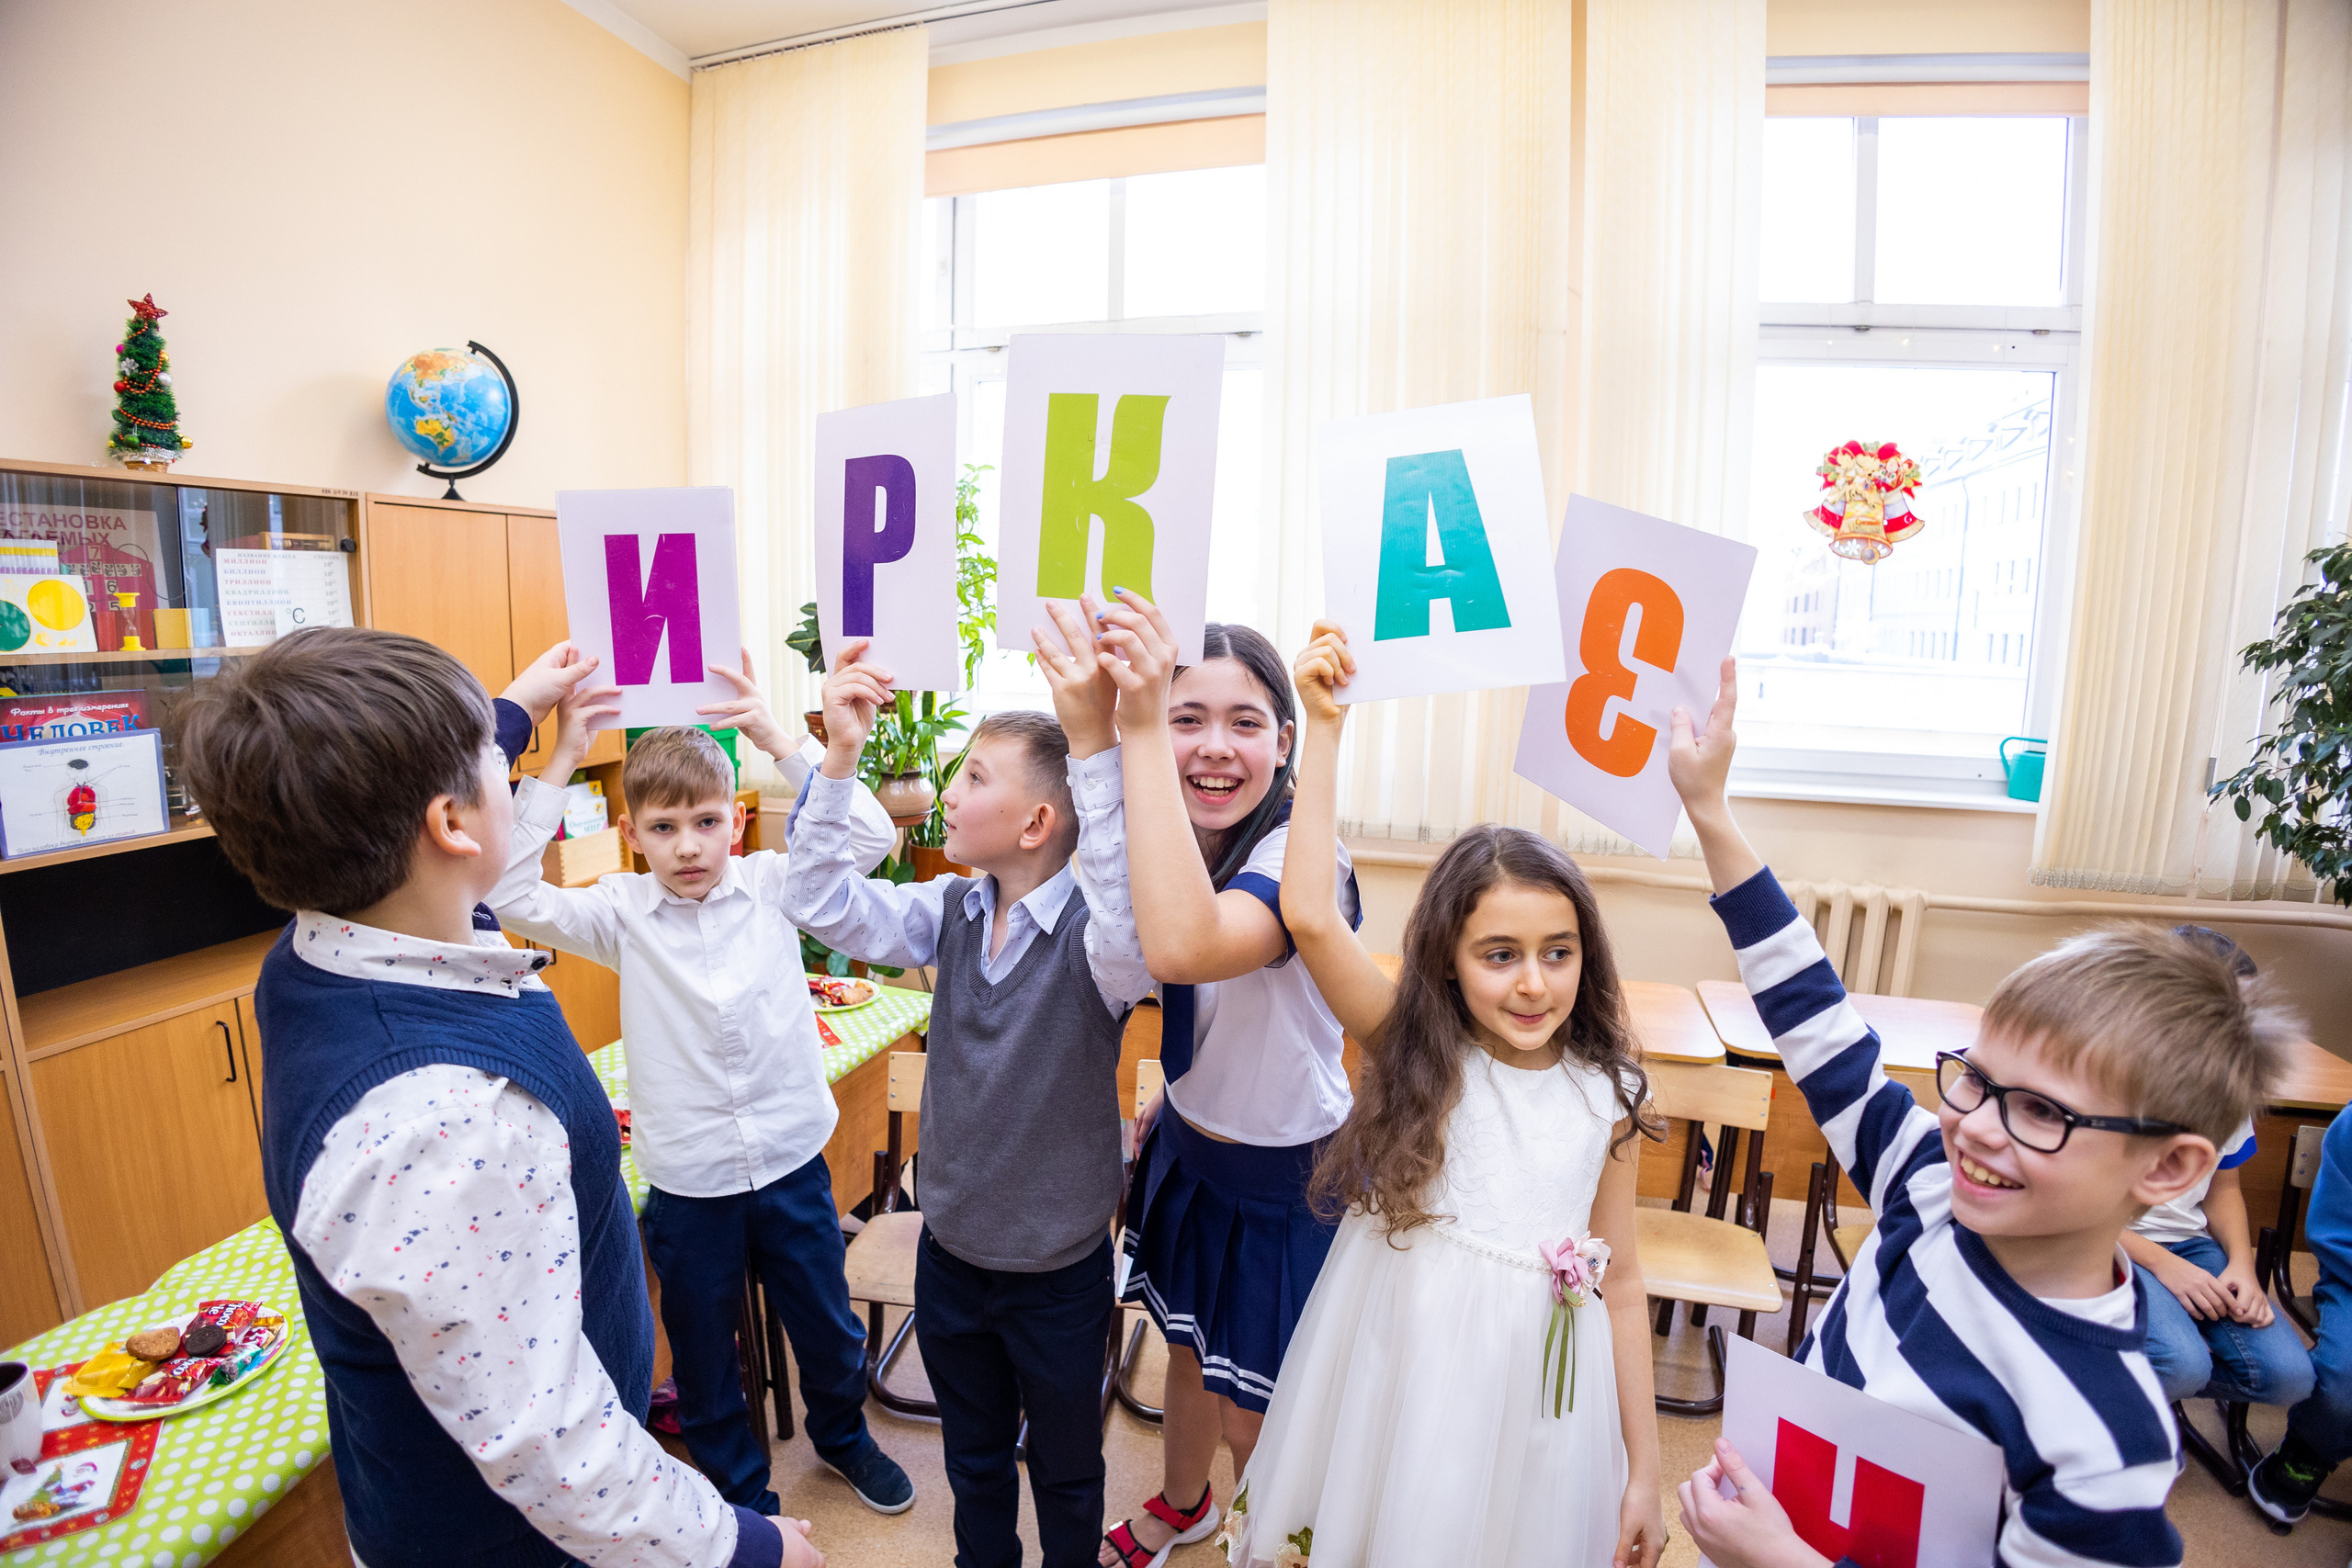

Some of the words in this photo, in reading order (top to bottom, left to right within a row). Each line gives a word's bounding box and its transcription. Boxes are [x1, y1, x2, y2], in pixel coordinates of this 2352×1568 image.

[90, 547, 100, 558] 7
[842, 454, 917, 637] Р
[1036, 392, 1171, 605] К
[1374, 448, 1512, 642] А
[107, 581, 117, 593] 6
[604, 533, 705, 686] И
[11, 707, 45, 716] Факты
[56, 705, 79, 716] трех
[81, 703, 130, 712] измерениях
